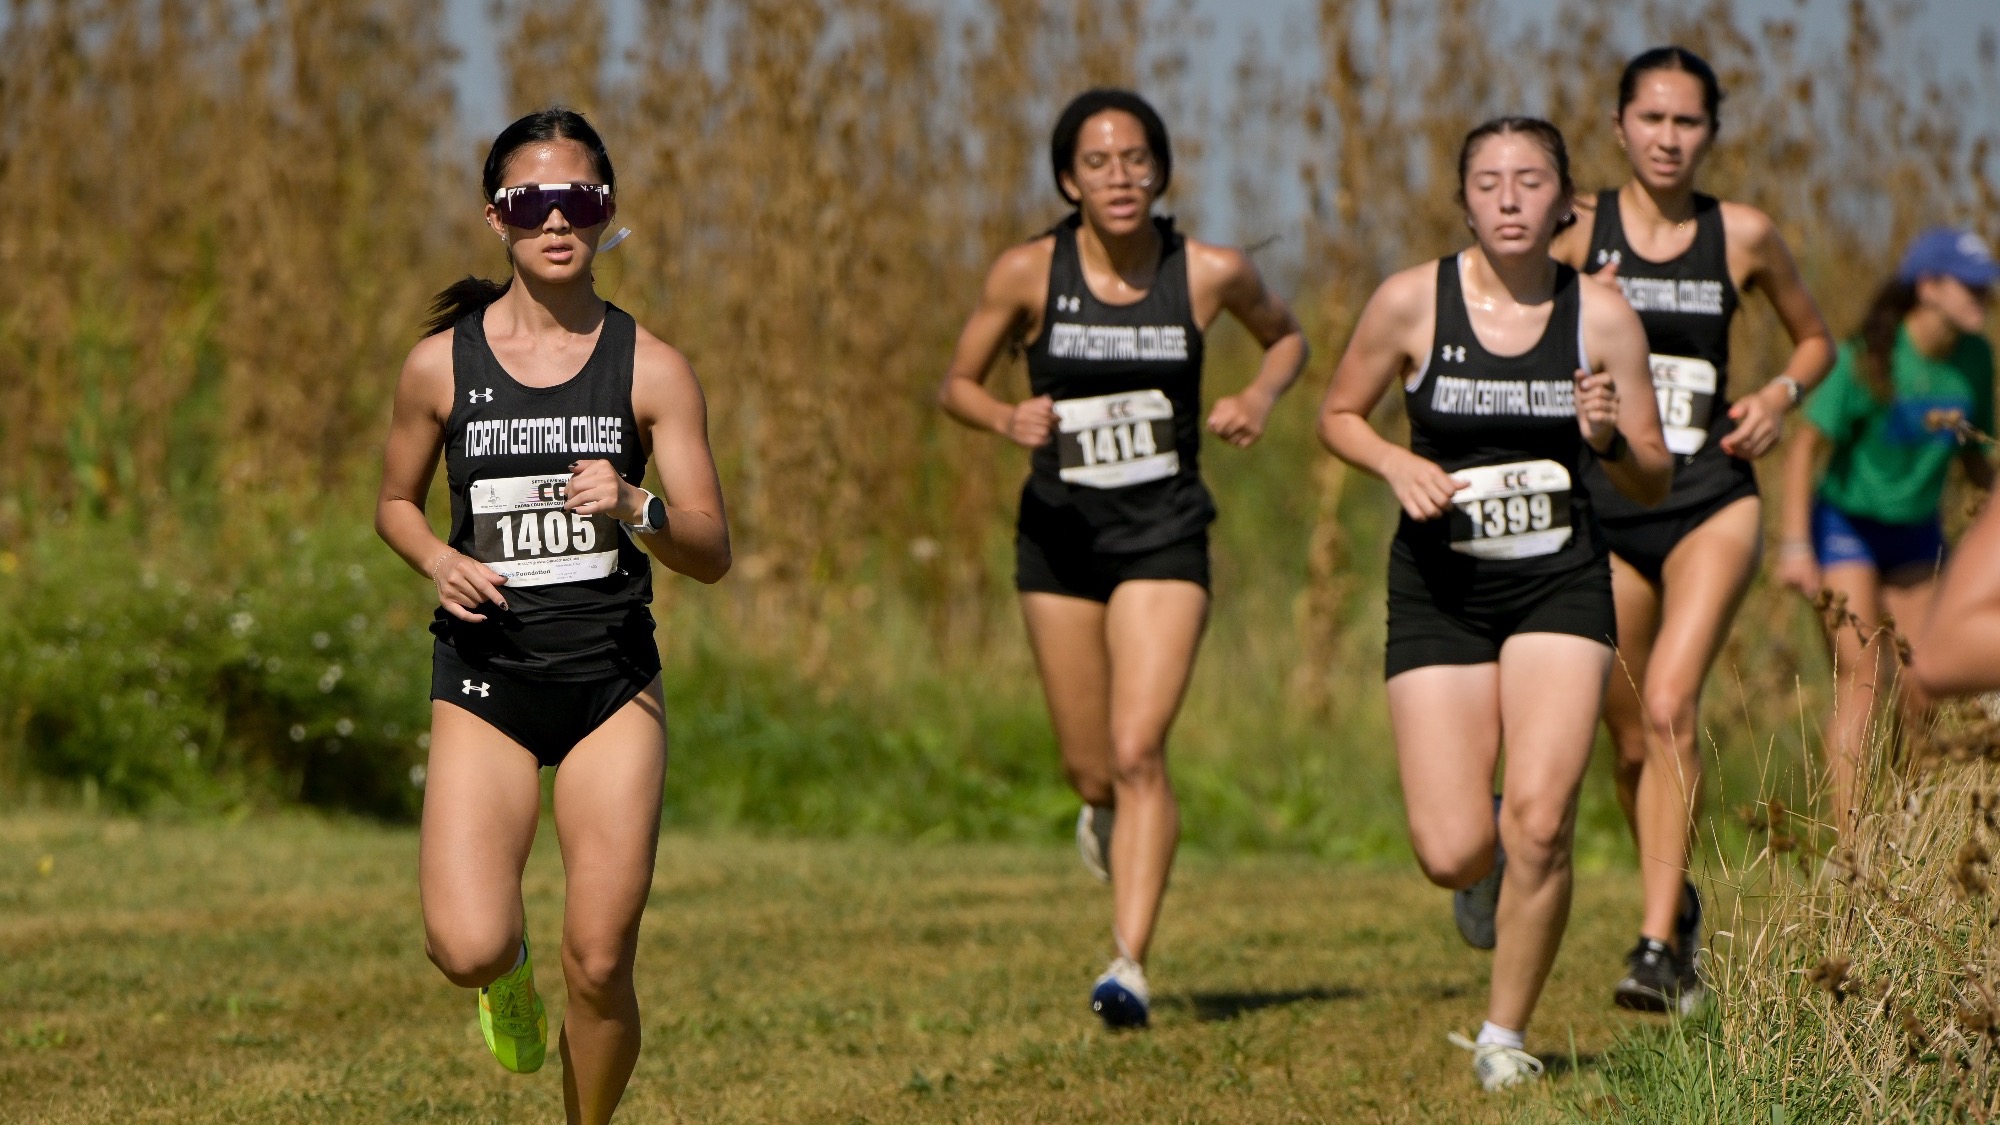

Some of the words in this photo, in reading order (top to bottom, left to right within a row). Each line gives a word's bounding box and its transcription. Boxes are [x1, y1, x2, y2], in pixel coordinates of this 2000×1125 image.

[1431, 375, 1475, 414] NORTH
[1474, 380, 1530, 415] CENTRAL
[465, 419, 509, 458] NORTH
[510, 416, 568, 455] CENTRAL
[570, 416, 622, 454] COLLEGE
[1077, 420, 1156, 466] 1414
[538, 482, 567, 501] CC
[1504, 471, 1529, 490] CC
[496, 510, 596, 558] 1405
[1466, 493, 1552, 539] 1399
[515, 569, 551, 577] Foundation
